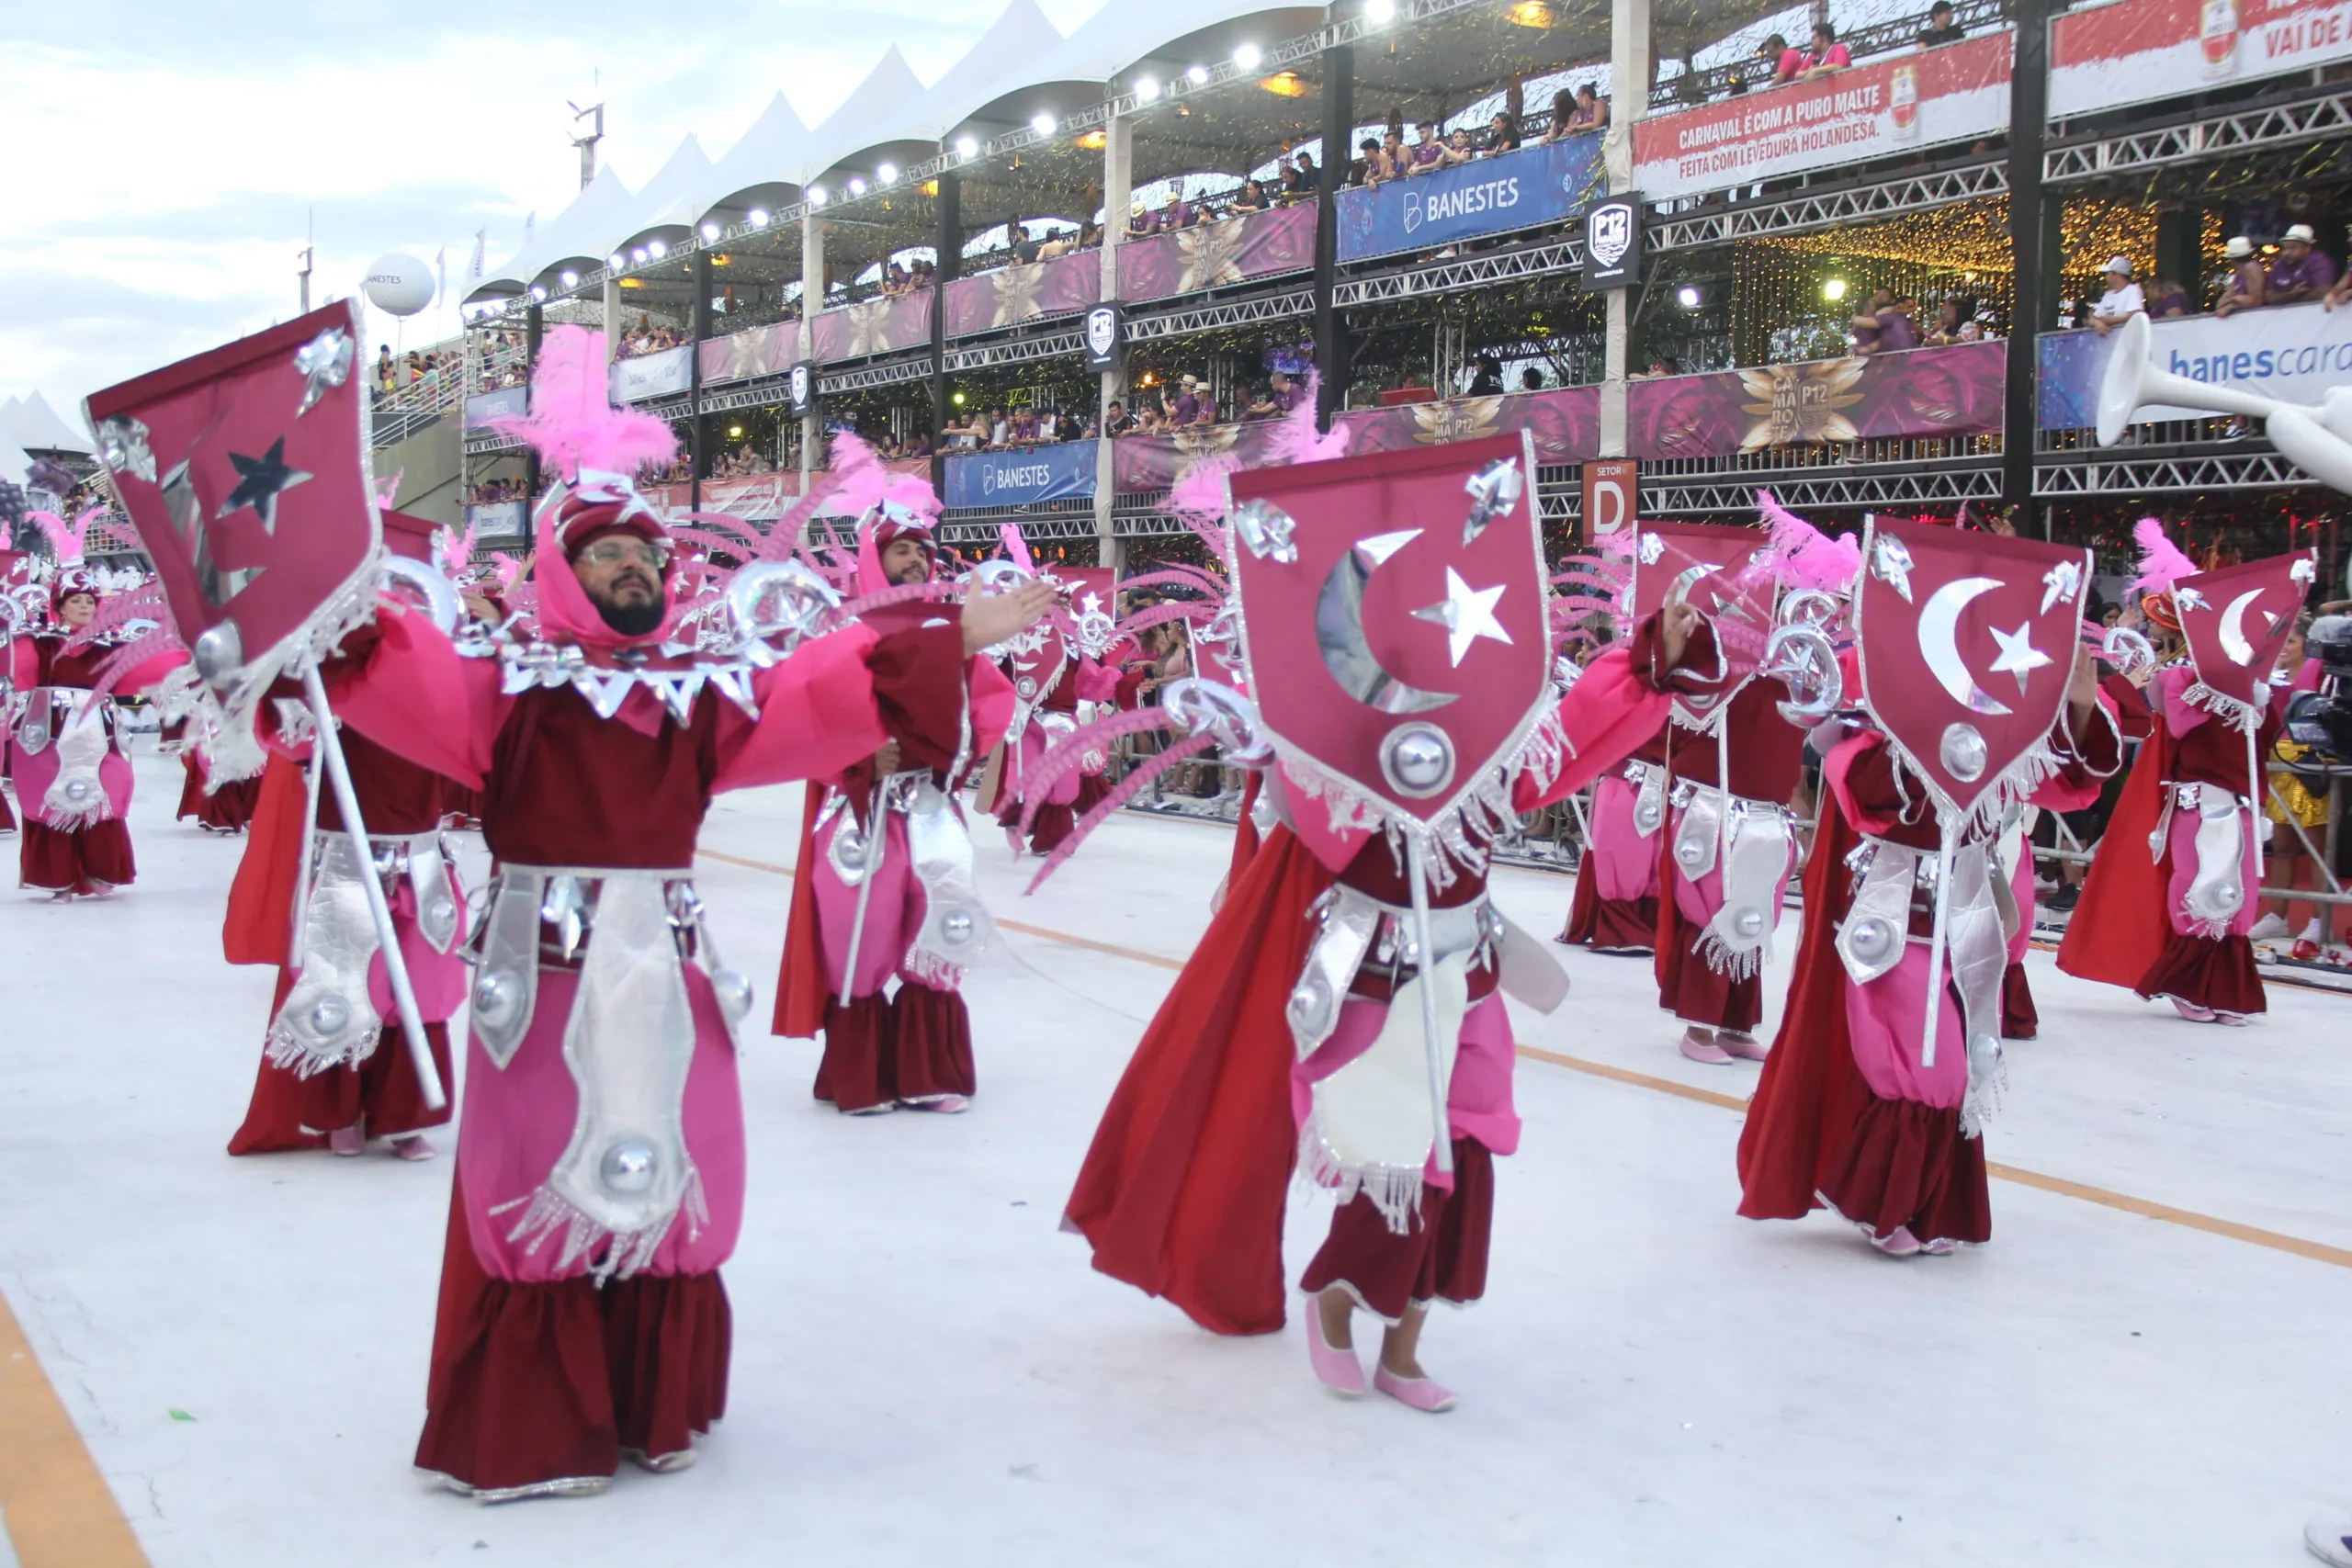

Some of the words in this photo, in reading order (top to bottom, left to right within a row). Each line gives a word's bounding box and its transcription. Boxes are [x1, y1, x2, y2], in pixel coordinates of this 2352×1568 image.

[2266, 25, 2304, 60] VAI
[2310, 14, 2341, 49] DE
[1679, 118, 1742, 150] CARNAVAL
[1745, 110, 1753, 135] É
[1753, 107, 1782, 132] COM
[1783, 104, 1792, 124] A
[1796, 96, 1832, 122] PURO
[1834, 85, 1881, 114] MALTE
[1679, 157, 1711, 180] FEITA
[1712, 151, 1738, 173] COM
[1740, 138, 1799, 167] LEVEDURA
[1801, 120, 1881, 152] HOLANDESA.
[1428, 177, 1520, 222] BANESTES
[1595, 211, 1626, 237] P12
[1091, 314, 1111, 333] P12
[1802, 384, 1828, 405] P12
[1454, 418, 1474, 435] P12
[997, 464, 1050, 490] BANESTES
[1597, 466, 1622, 477] SETOR
[1593, 480, 1625, 535] D
